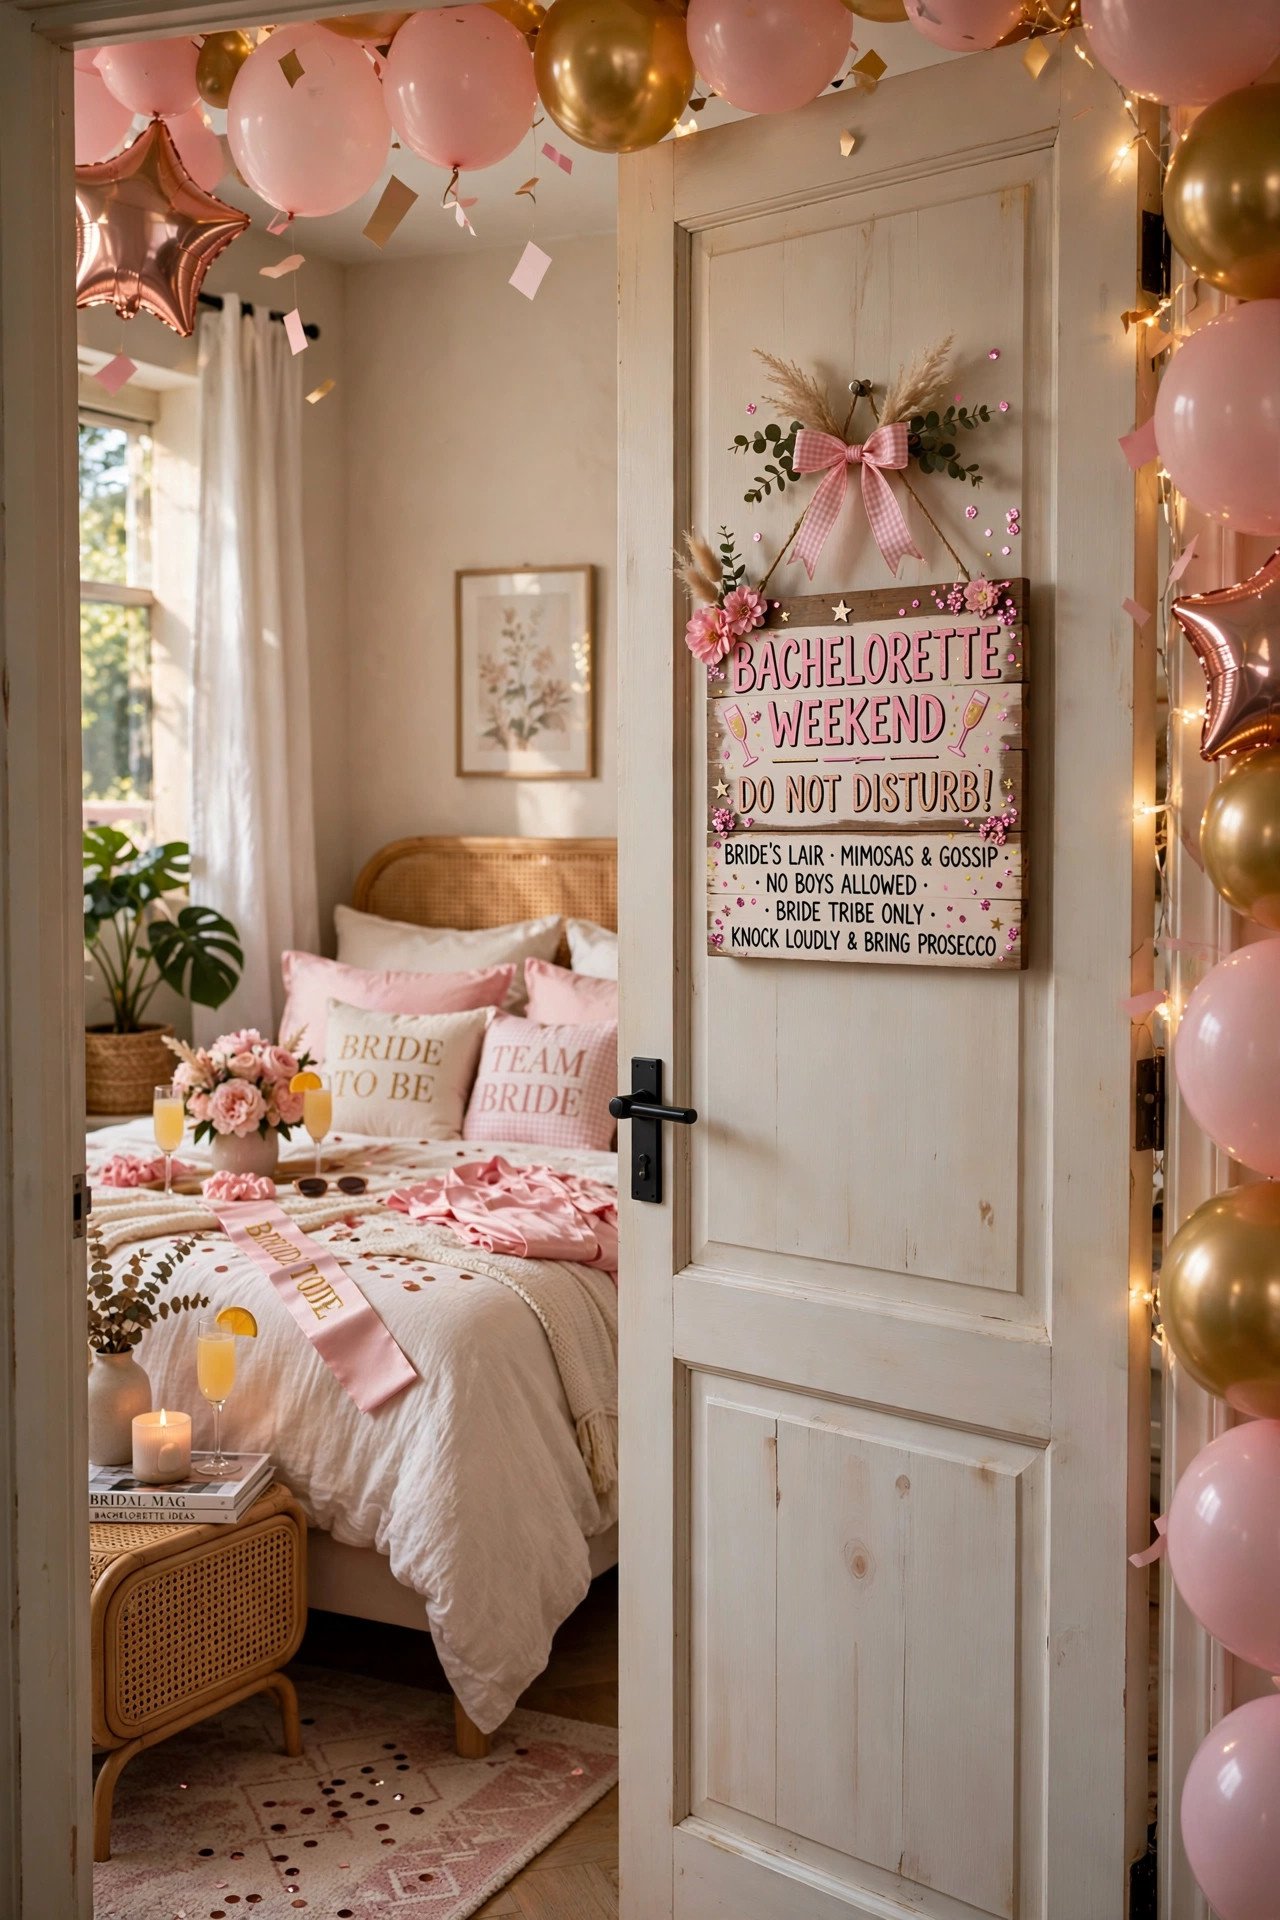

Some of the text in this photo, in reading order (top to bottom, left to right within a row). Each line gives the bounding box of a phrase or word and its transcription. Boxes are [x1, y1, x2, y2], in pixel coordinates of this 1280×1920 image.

[732, 625, 1002, 694] BACHELORETTE
[768, 693, 946, 748] WEEKEND
[738, 769, 993, 813] DO NOT DISTURB!
[724, 842, 999, 868] BRIDE'S LAIR MIMOSAS & GOSSIP
[766, 873, 917, 895] NO BOYS ALLOWED
[776, 900, 924, 925] BRIDE TRIBE ONLY
[731, 926, 996, 956] KNOCK LOUDLY & BRING PROSECCO
[338, 1034, 444, 1066] BRIDE
[490, 1044, 588, 1078] TEAM
[334, 1069, 435, 1103] TO BE
[479, 1083, 583, 1117] BRIDE
[90, 1494, 186, 1508] BRIDAL MAG
[168, 1512, 195, 1520] IDEAS
